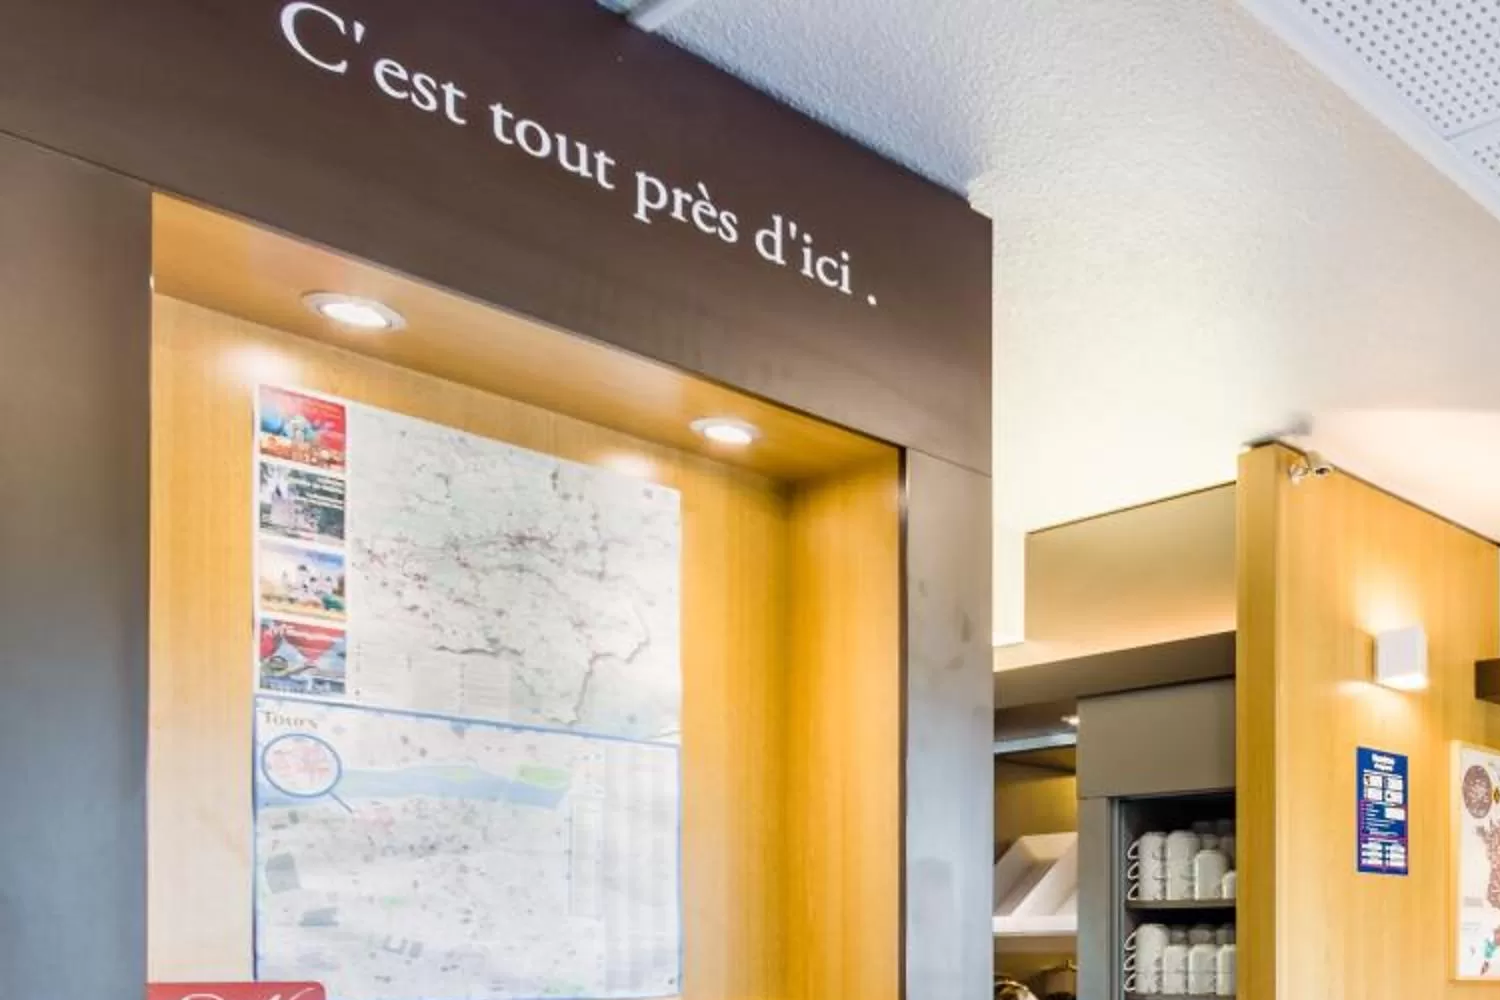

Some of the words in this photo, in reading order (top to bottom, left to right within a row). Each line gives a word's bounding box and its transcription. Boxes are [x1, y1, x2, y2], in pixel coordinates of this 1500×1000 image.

[280, 0, 466, 125] C'est
[490, 102, 616, 190] tout
[633, 169, 739, 244] près
